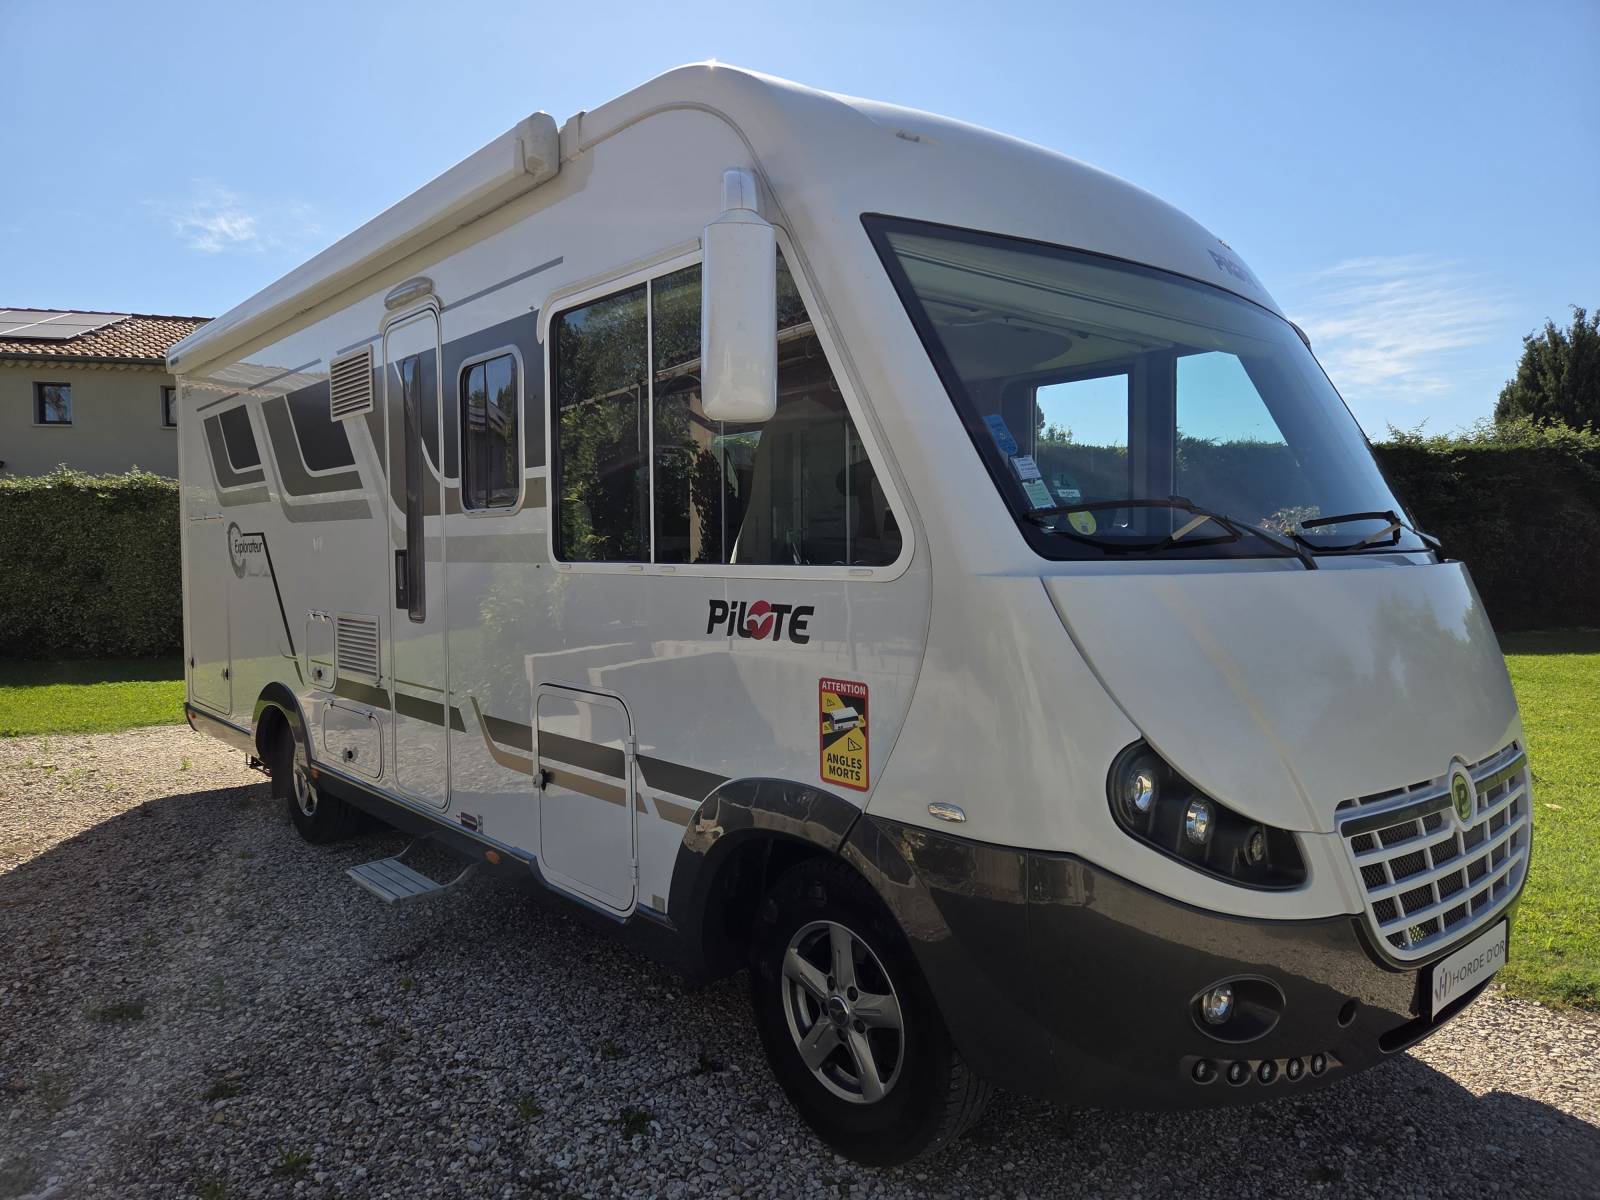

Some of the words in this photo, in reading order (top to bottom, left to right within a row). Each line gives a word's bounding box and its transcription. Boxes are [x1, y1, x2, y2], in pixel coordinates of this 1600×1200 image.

[821, 680, 867, 696] ATTENTION
[826, 752, 863, 770] ANGLES
[828, 765, 862, 781] MORTS
[1452, 953, 1485, 987] HORDE
[1486, 940, 1506, 964] D'OR
